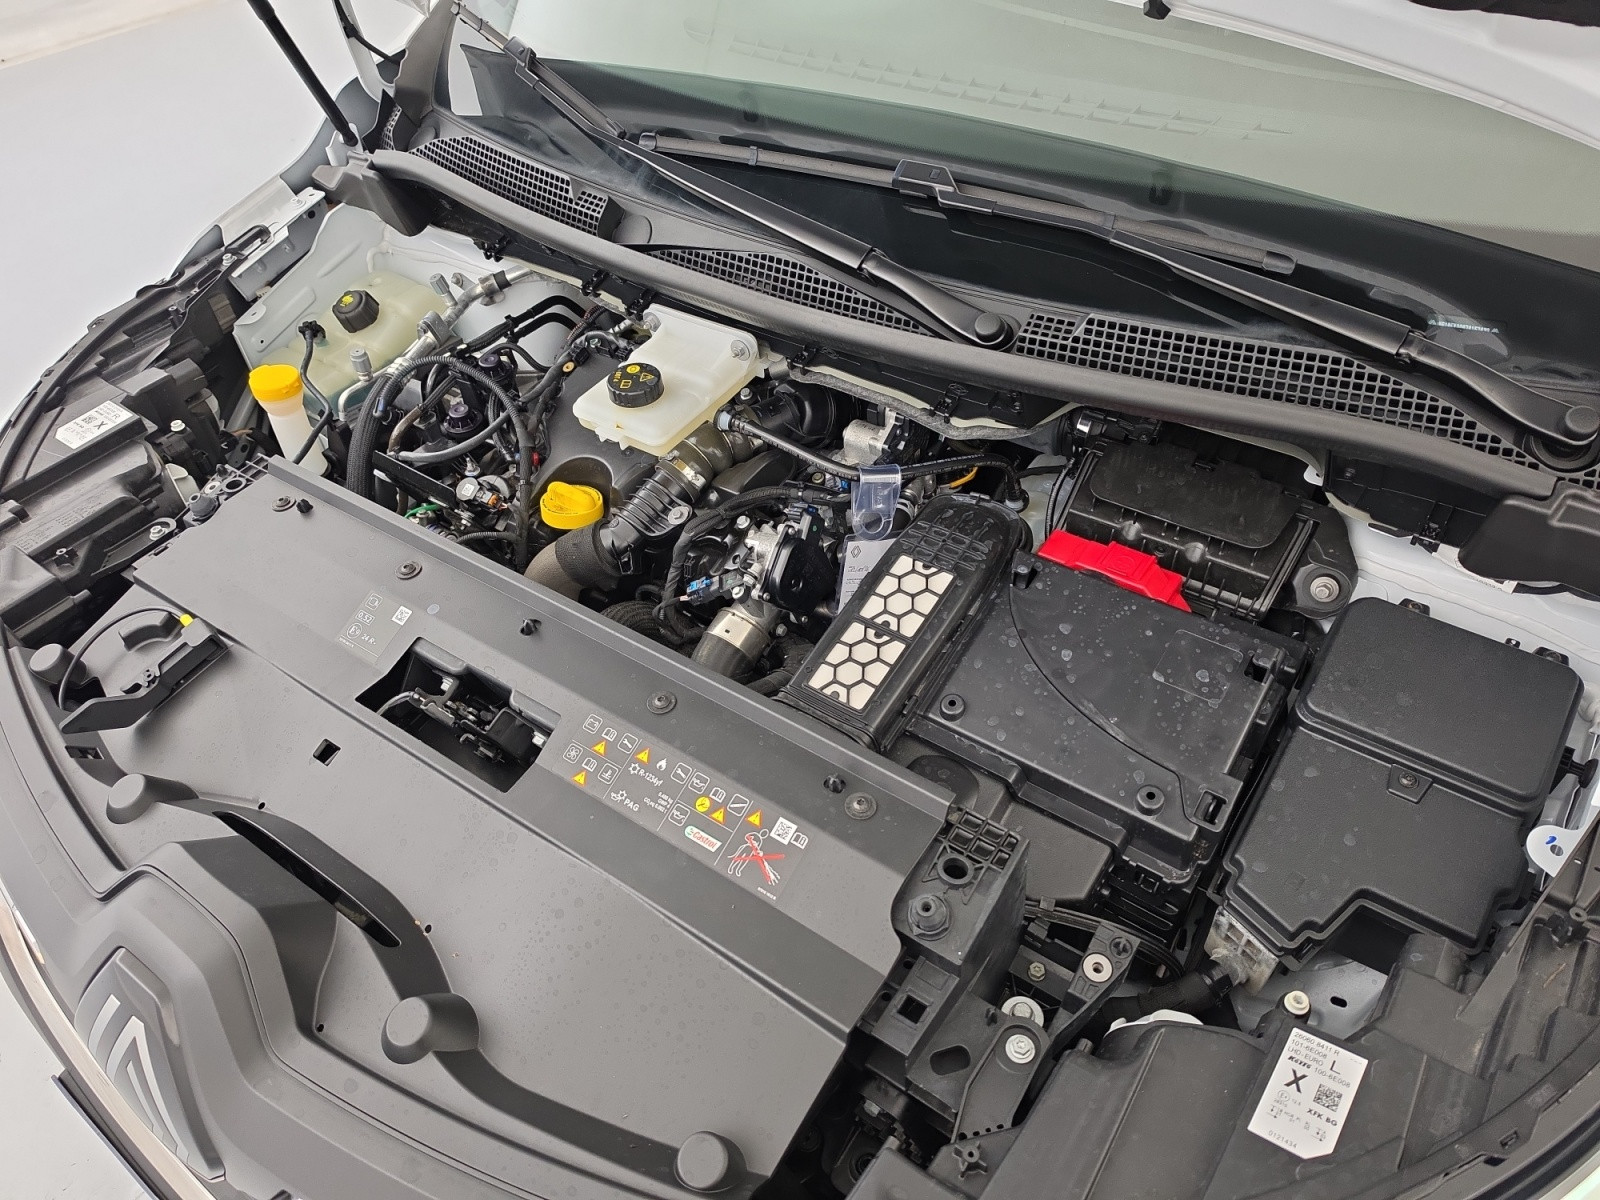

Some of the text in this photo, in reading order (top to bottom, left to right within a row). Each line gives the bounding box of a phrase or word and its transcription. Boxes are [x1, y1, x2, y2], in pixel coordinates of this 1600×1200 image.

[94, 420, 108, 430] X
[638, 767, 664, 788] R-1234yf
[624, 797, 640, 812] PAG
[692, 832, 718, 850] Castrol
[1291, 1040, 1328, 1060] 101-6E008
[1293, 1032, 1315, 1046] 26060
[1316, 1041, 1333, 1053] 8411
[1330, 1060, 1341, 1074] L
[1284, 1068, 1308, 1094] X
[1314, 1066, 1352, 1088] 100-6E008
[1307, 1108, 1323, 1120] XFK
